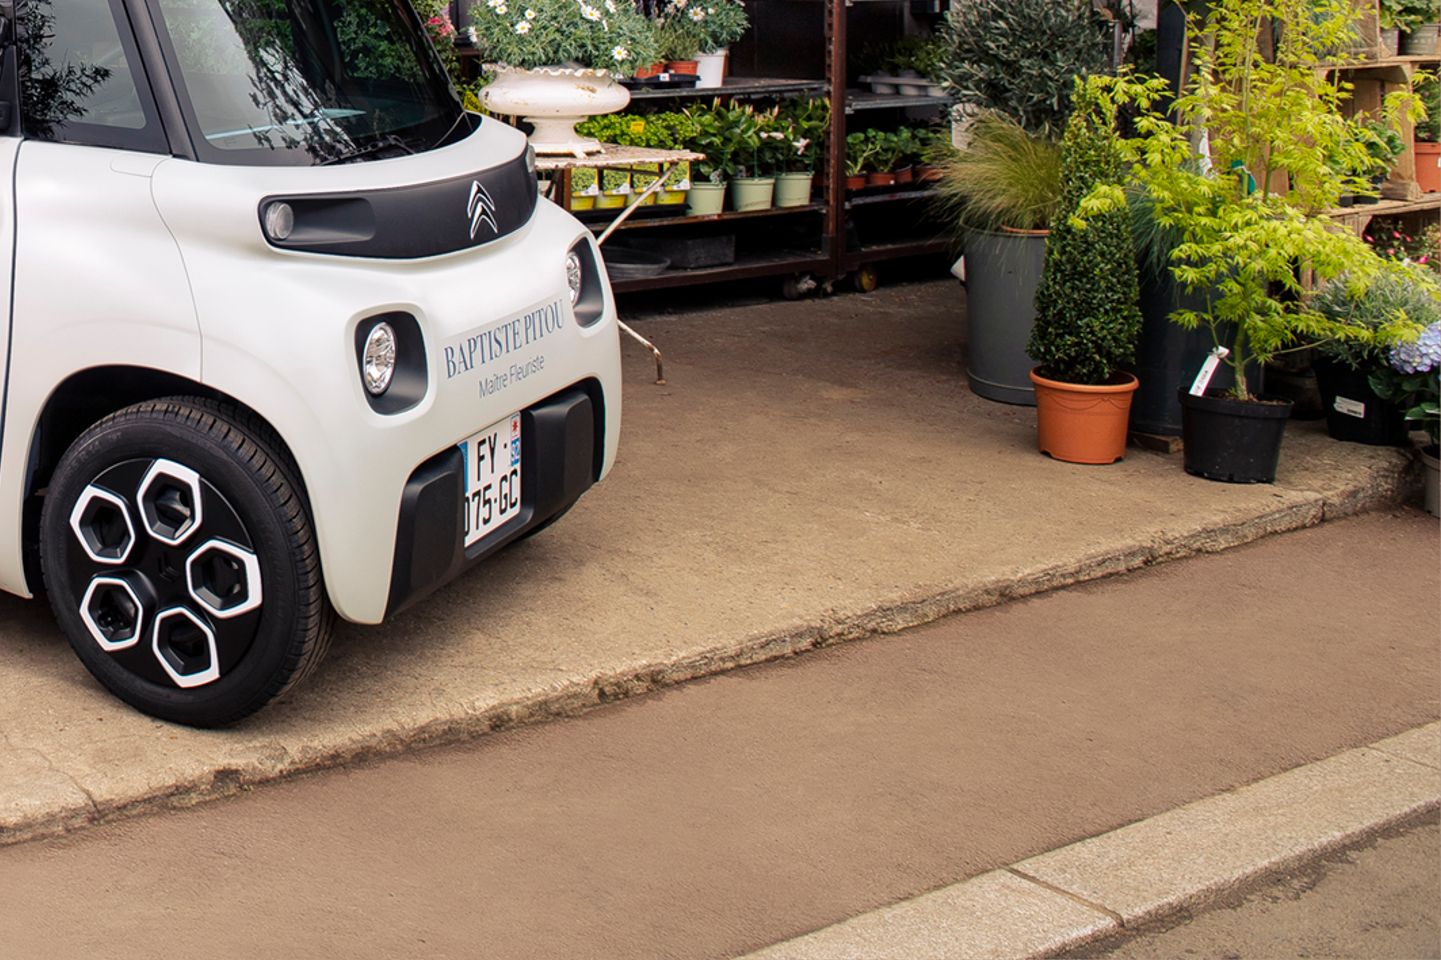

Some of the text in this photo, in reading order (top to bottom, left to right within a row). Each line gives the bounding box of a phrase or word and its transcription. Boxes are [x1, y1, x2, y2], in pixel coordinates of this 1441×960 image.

[444, 299, 564, 379] BAPTISTE PITOU
[478, 355, 545, 398] Maître Fleuriste
